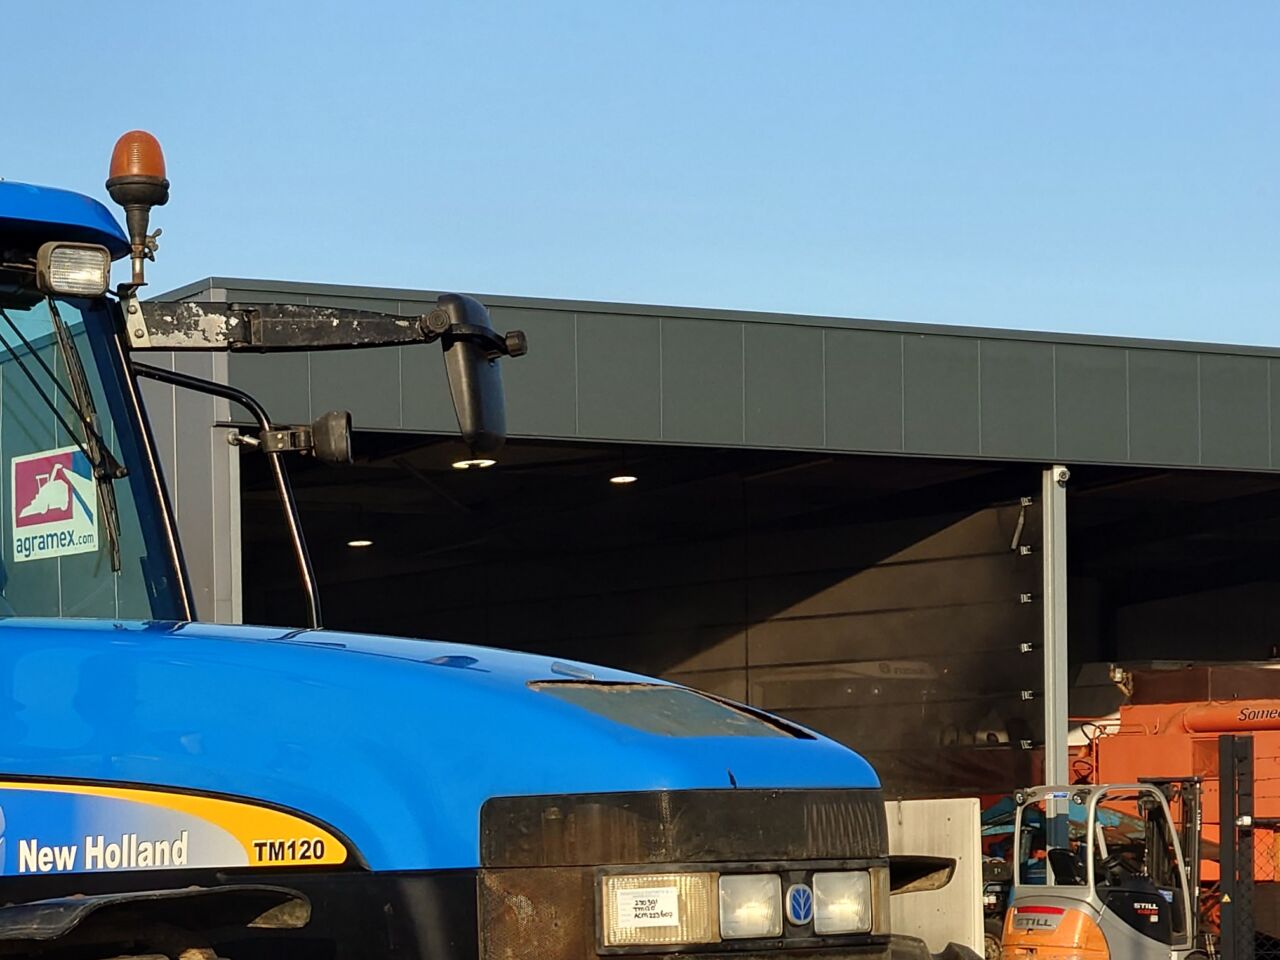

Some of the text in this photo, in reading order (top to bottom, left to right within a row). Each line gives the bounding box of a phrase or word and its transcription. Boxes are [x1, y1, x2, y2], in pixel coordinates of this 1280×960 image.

[16, 530, 95, 557] agramex.com
[18, 830, 326, 873] New Holland TM120
